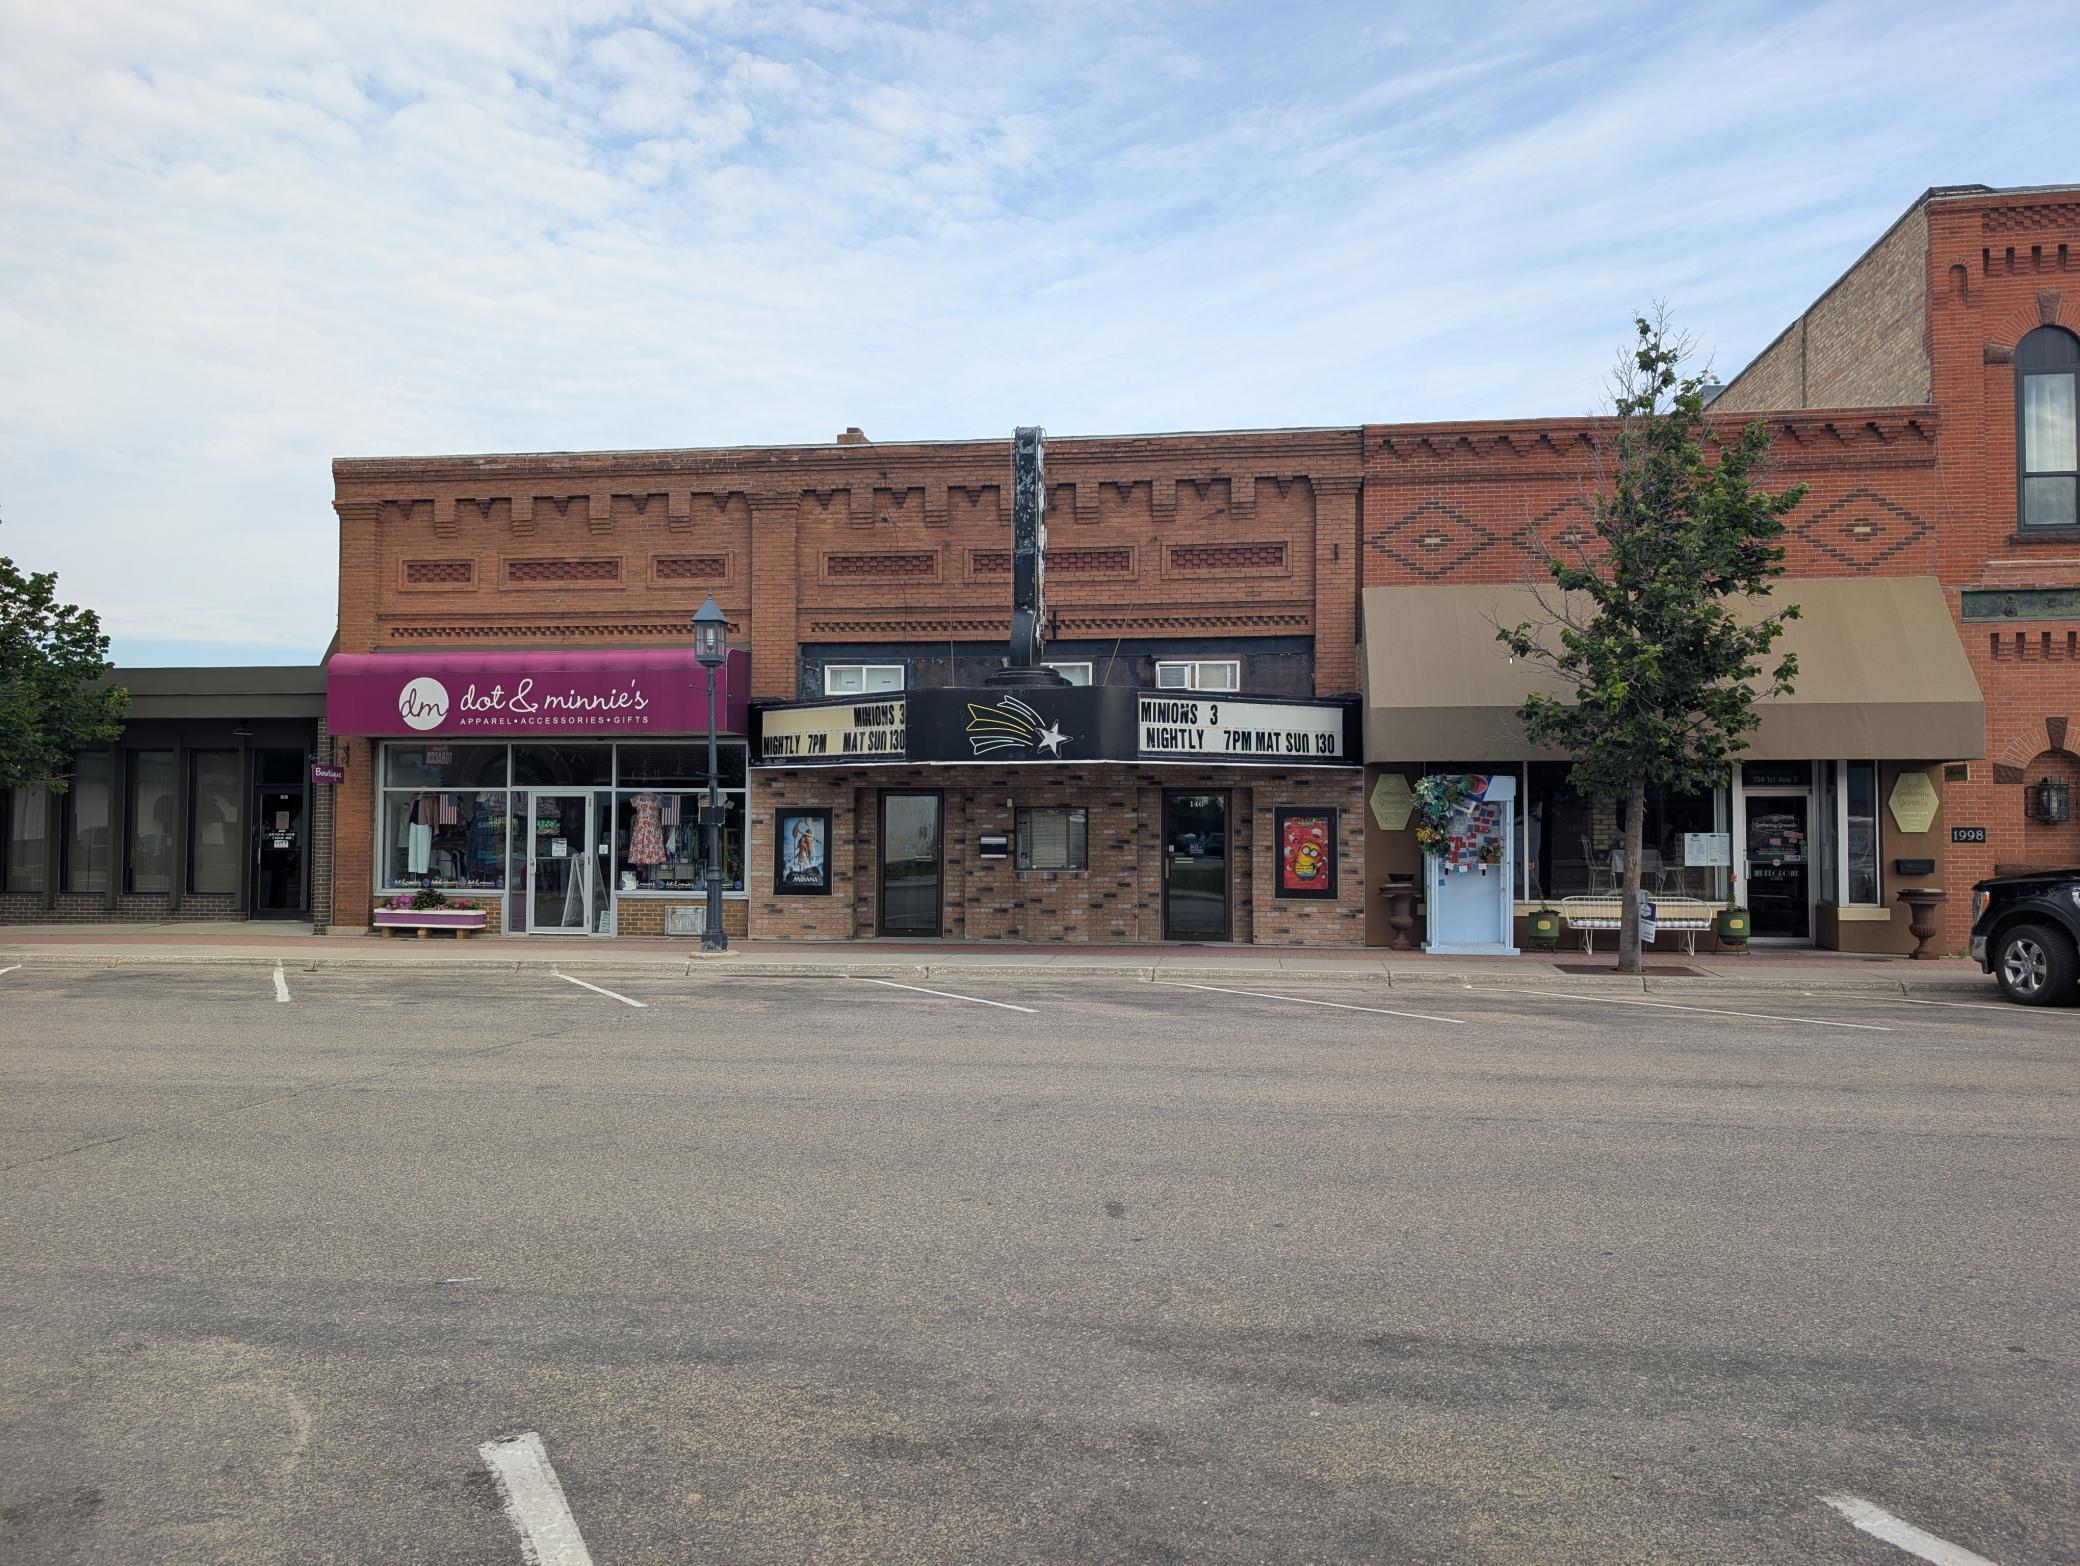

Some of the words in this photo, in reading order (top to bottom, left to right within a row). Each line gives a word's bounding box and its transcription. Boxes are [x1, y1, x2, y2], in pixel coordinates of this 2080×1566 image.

[460, 684, 506, 711] dot
[508, 678, 538, 713] &
[544, 678, 649, 710] minnie's
[460, 717, 512, 726] APPAREL
[521, 716, 604, 725] ACCESSORIES
[613, 716, 649, 724] GIFTS
[853, 704, 895, 728] MINIONS
[899, 703, 905, 724] 3
[1140, 701, 1198, 725] MINIONS
[1209, 704, 1218, 725] 3
[763, 735, 800, 755] NIGHTLY
[807, 733, 828, 754] 7PM
[843, 731, 865, 753] MAT
[889, 729, 905, 750] 130
[1146, 727, 1204, 750] NIGHTLY
[1224, 730, 1252, 751] 7PM
[1256, 731, 1281, 752] MAT
[1315, 733, 1335, 754] 130
[315, 767, 342, 781] Boutique
[1953, 830, 1984, 841] 1998
